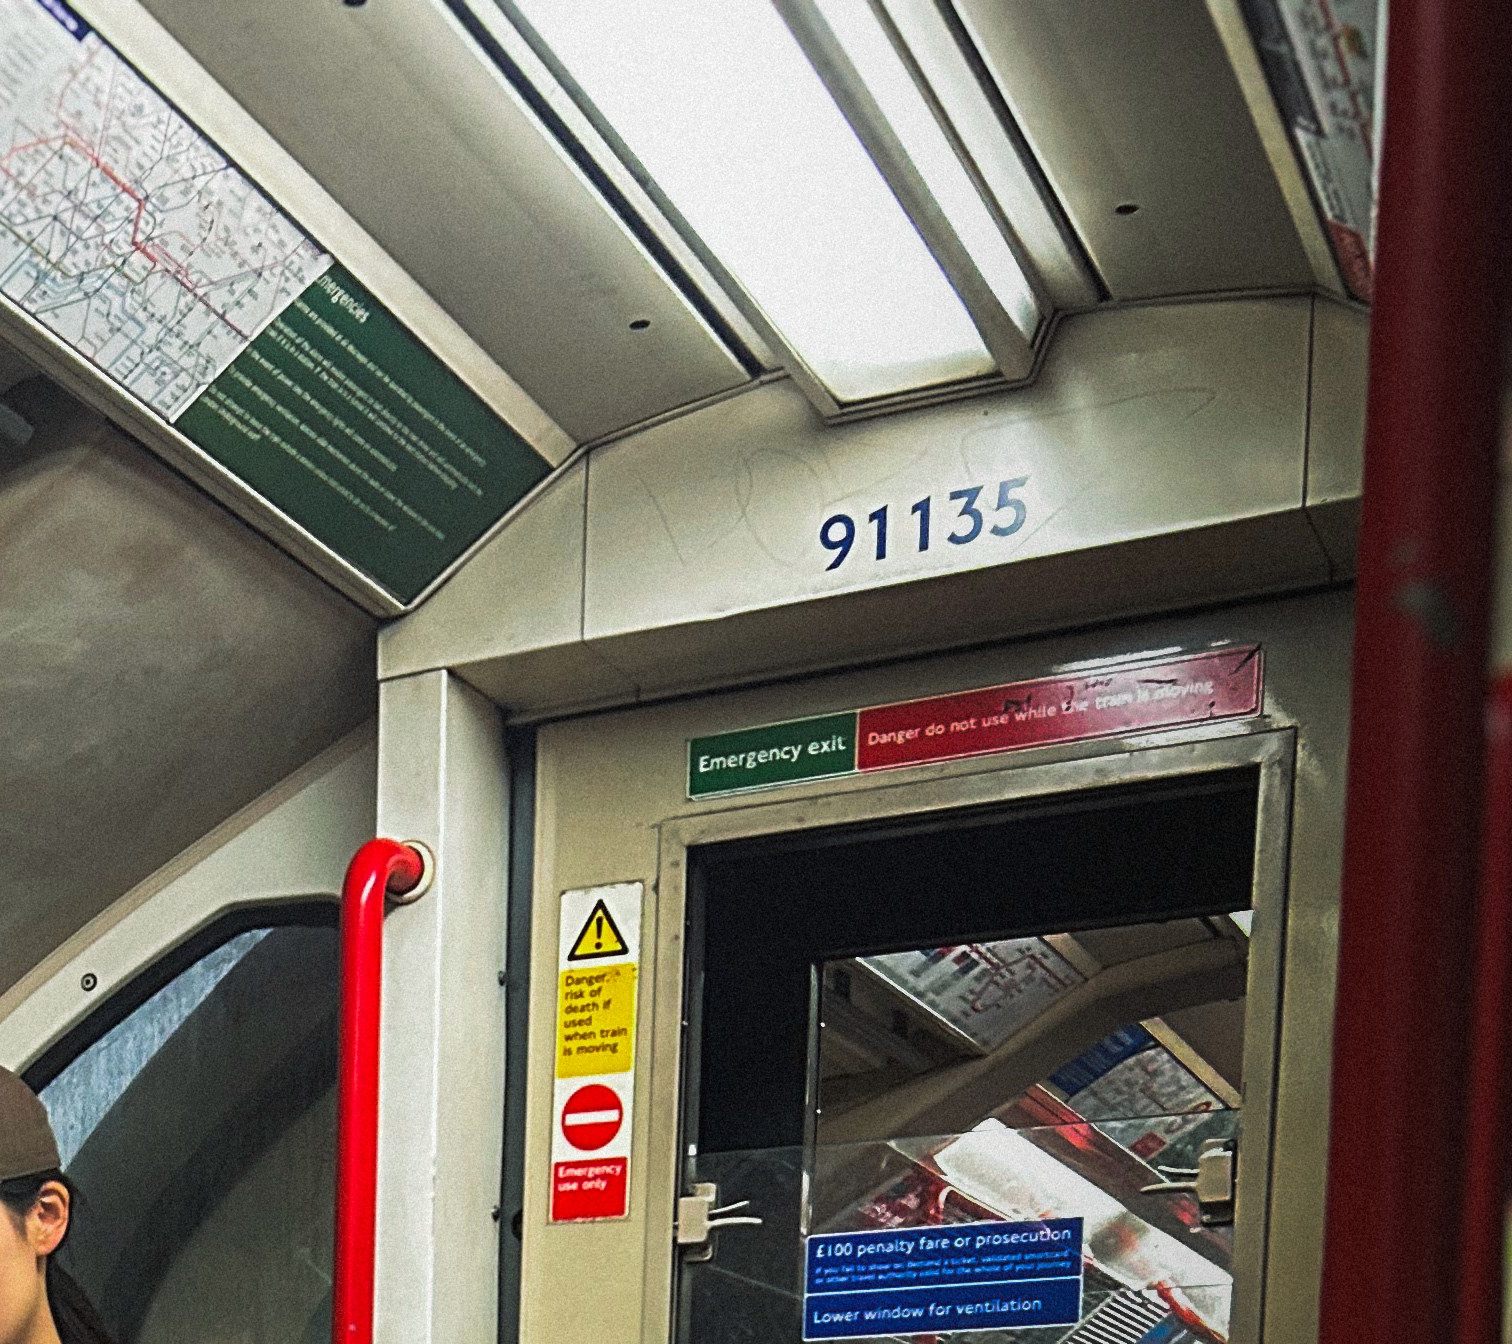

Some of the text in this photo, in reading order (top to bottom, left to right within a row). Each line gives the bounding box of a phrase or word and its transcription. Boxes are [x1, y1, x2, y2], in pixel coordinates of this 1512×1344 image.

[315, 275, 370, 323] mergencies
[820, 475, 1031, 571] 91135
[867, 727, 921, 746] Danger
[925, 722, 945, 737] do
[950, 718, 977, 733] not
[981, 714, 1008, 727] use
[1014, 703, 1056, 721] while
[698, 735, 846, 773] Emergency exit
[564, 986, 602, 1000] risk of
[565, 1001, 599, 1014] death
[564, 1016, 592, 1028] used
[564, 1026, 627, 1041] when train
[563, 1042, 618, 1056] is moving
[558, 1165, 622, 1178] Emergency
[558, 1178, 607, 1192] use only
[815, 1227, 1071, 1258] £100 penalty fare or prosecution
[814, 1298, 1042, 1324] Lower window for ventilation
